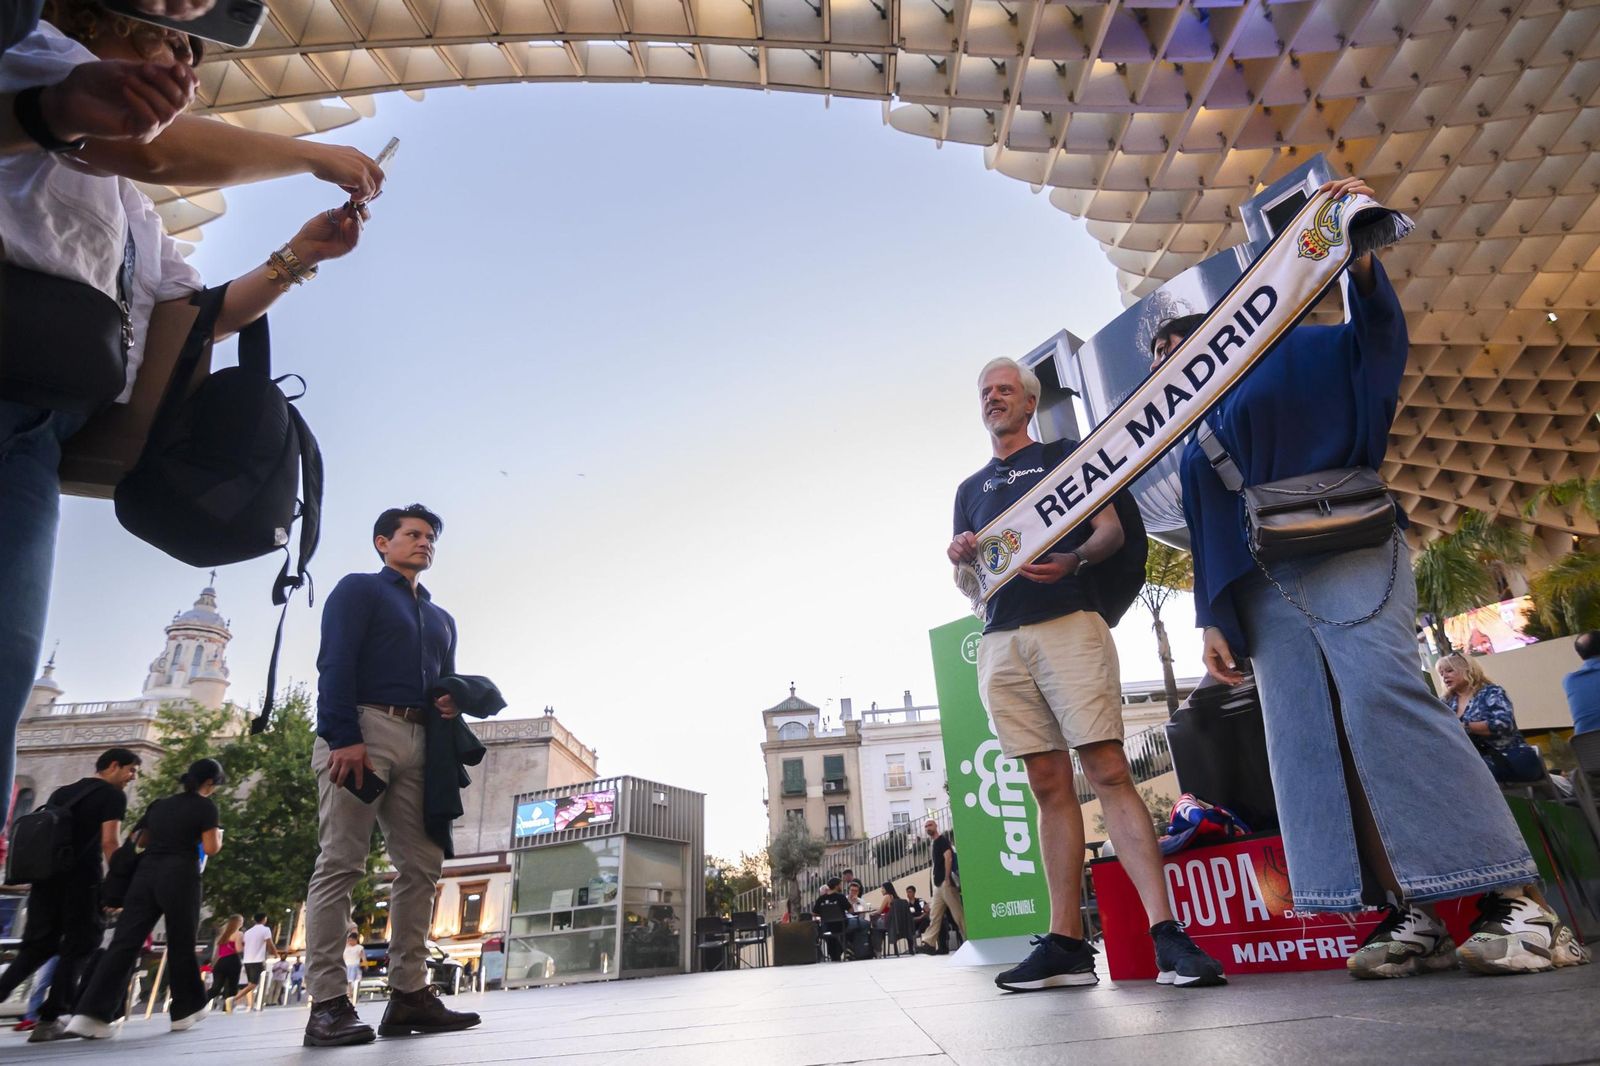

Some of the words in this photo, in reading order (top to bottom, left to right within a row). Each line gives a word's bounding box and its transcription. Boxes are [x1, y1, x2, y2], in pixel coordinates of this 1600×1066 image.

[1034, 448, 1128, 528] REAL
[1125, 285, 1278, 448] MADRID
[1007, 466, 1045, 485] Jeans
[1163, 852, 1270, 929] COPA
[1231, 935, 1358, 964] MAPFRE
